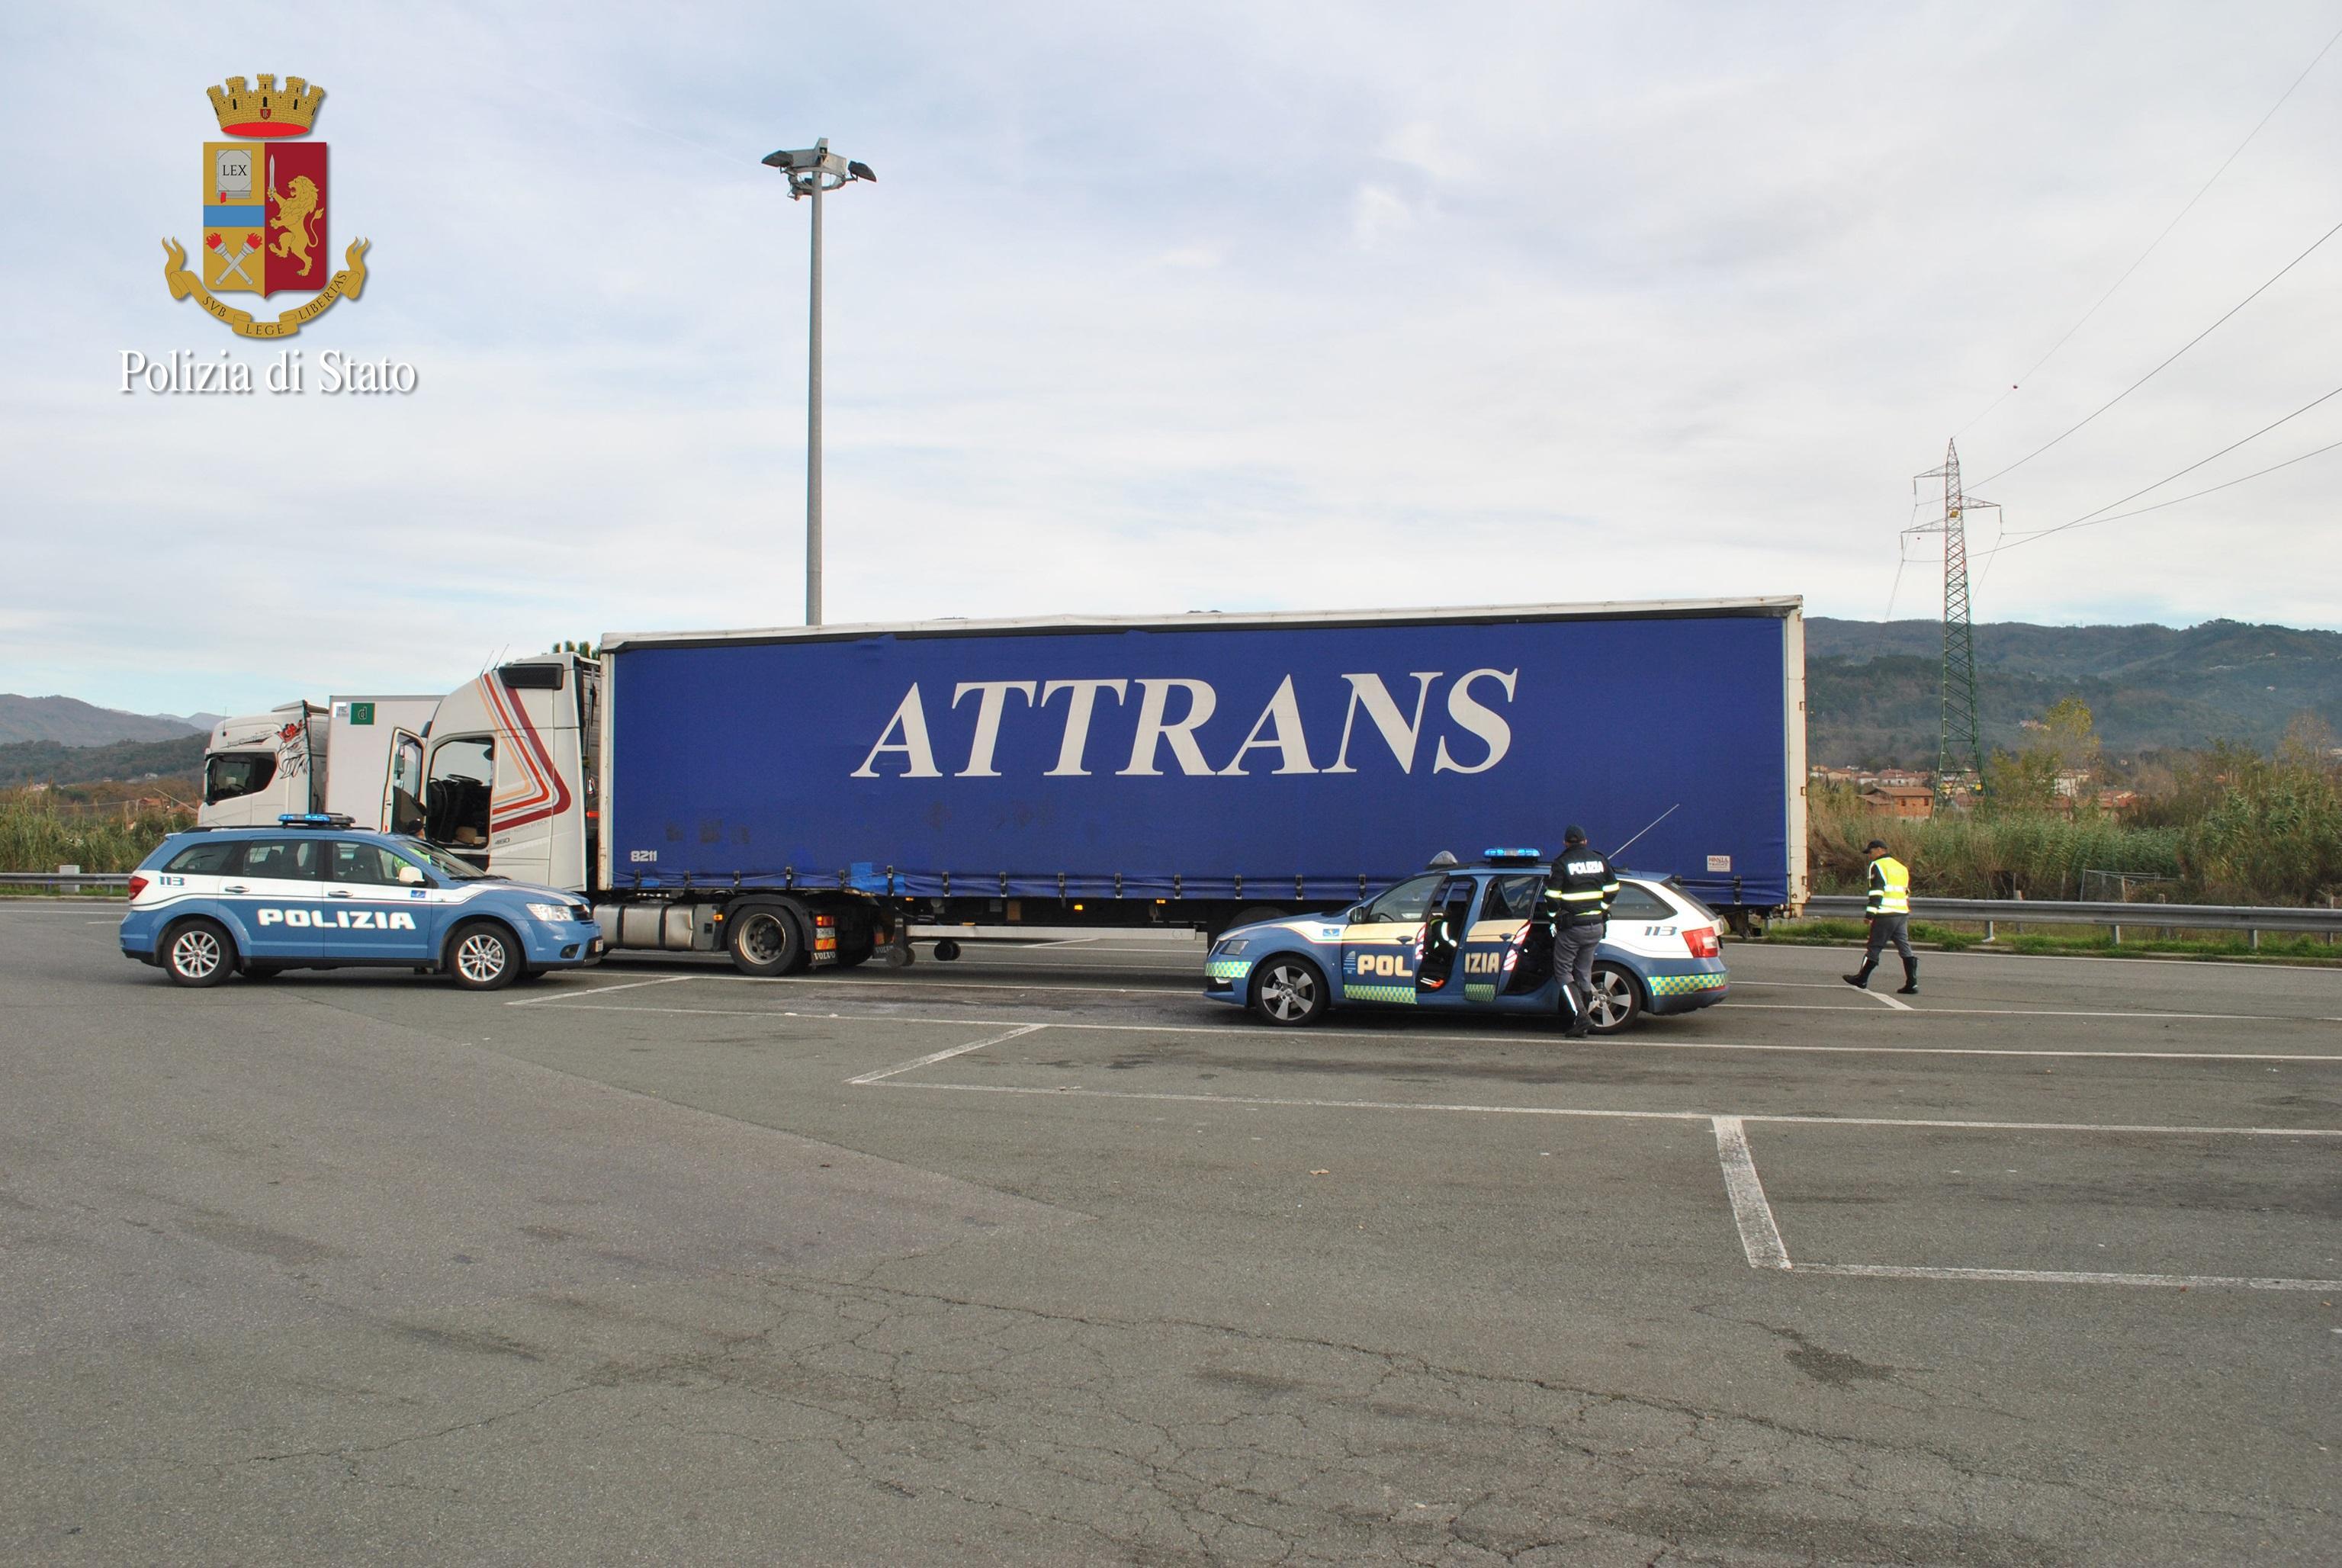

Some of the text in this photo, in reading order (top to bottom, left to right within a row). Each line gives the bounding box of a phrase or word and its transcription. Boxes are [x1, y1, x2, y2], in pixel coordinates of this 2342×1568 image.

[850, 667, 1518, 777] ATTRANS
[631, 850, 657, 862] 8211
[1567, 860, 1605, 876] POLIZIA
[159, 876, 185, 886] 113
[258, 908, 416, 930] POLIZIA
[1644, 926, 1677, 936] 113
[814, 951, 836, 960] VOLVO
[1357, 952, 1500, 977] POL IZIA
